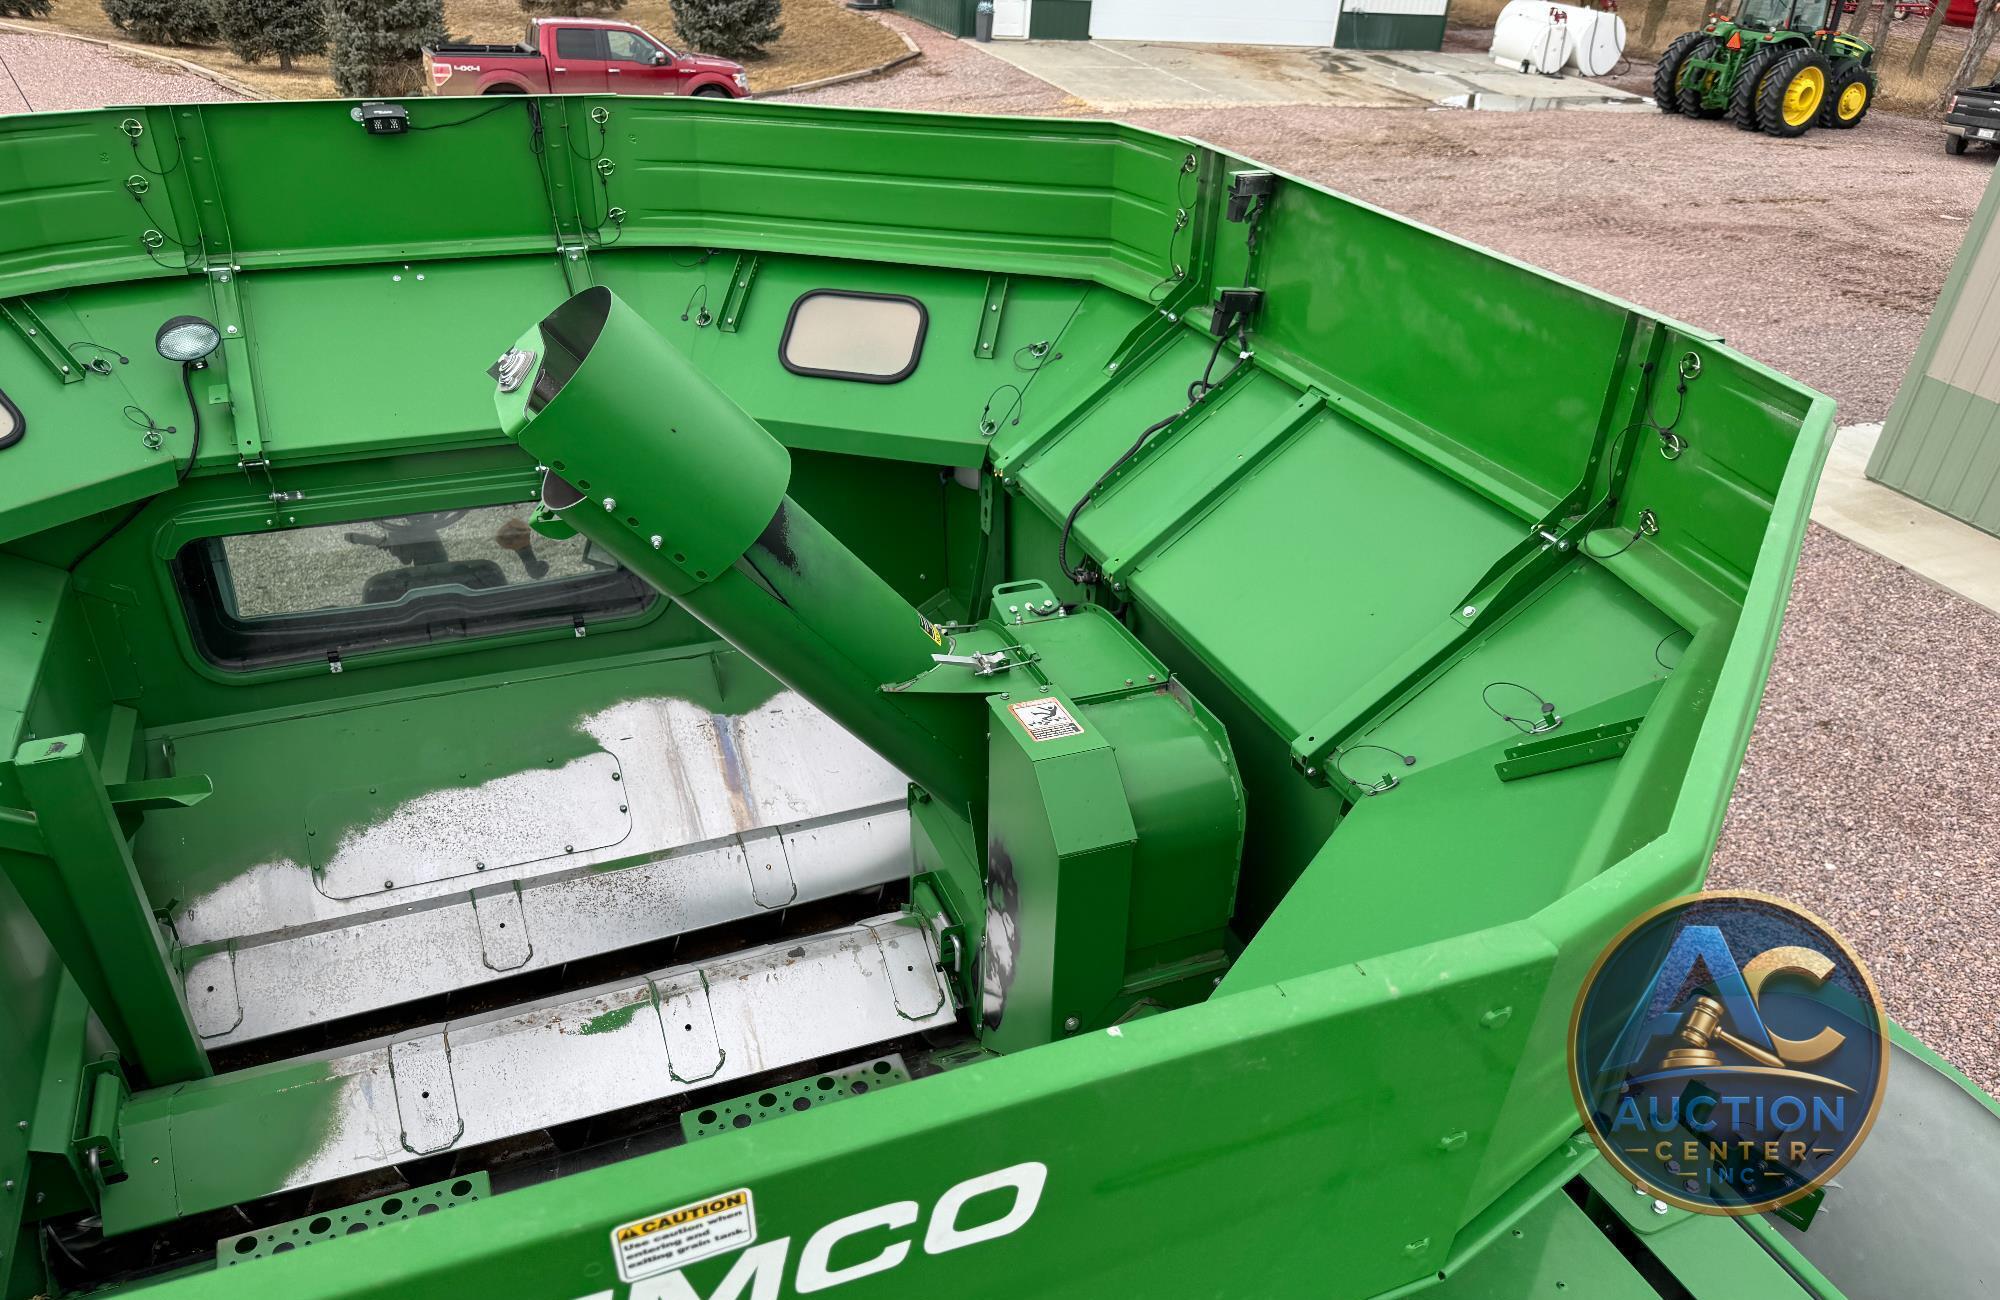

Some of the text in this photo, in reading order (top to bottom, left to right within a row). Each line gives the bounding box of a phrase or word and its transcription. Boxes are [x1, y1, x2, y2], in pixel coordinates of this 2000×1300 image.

[624, 1210, 743, 1251] Use caution when
[642, 1194, 742, 1233] CAUTION
[626, 1229, 711, 1261] entering and
[628, 1227, 747, 1269] exiting grain tank.
